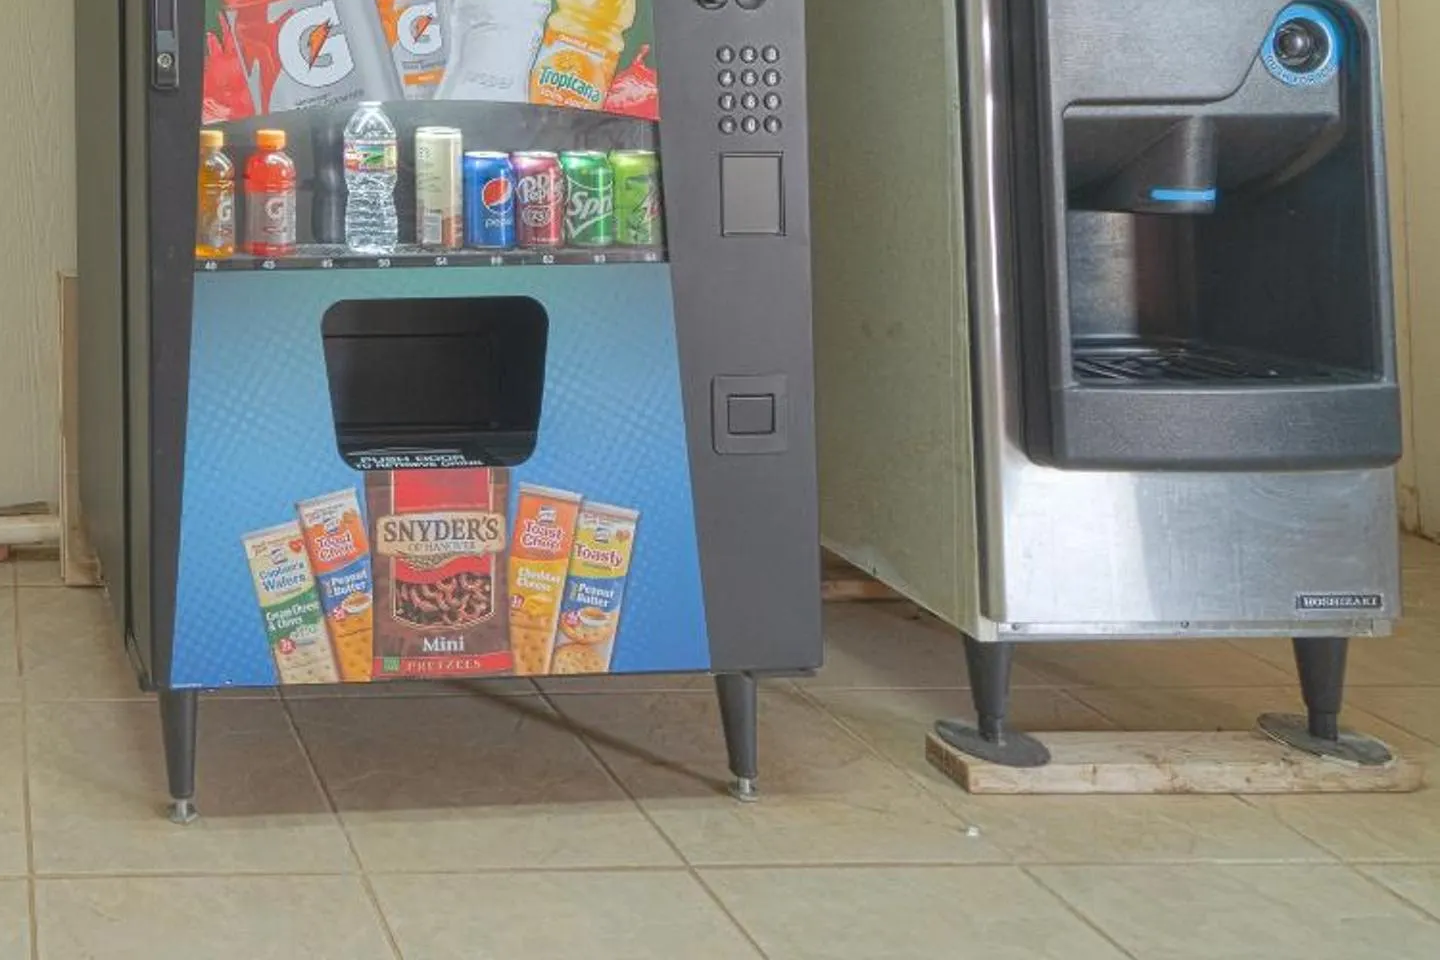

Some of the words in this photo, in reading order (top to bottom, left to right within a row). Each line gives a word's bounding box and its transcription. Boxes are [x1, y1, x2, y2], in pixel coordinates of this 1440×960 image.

[397, 1, 443, 56] G
[277, 0, 356, 88] G
[539, 66, 601, 103] Tropicana
[264, 196, 285, 221] G
[383, 517, 499, 542] SNYDER'S
[575, 542, 624, 567] Toasty
[576, 592, 609, 607] Butter
[578, 582, 615, 598] Peanut
[421, 635, 465, 652] Mini
[406, 658, 481, 673] PRETZELS
